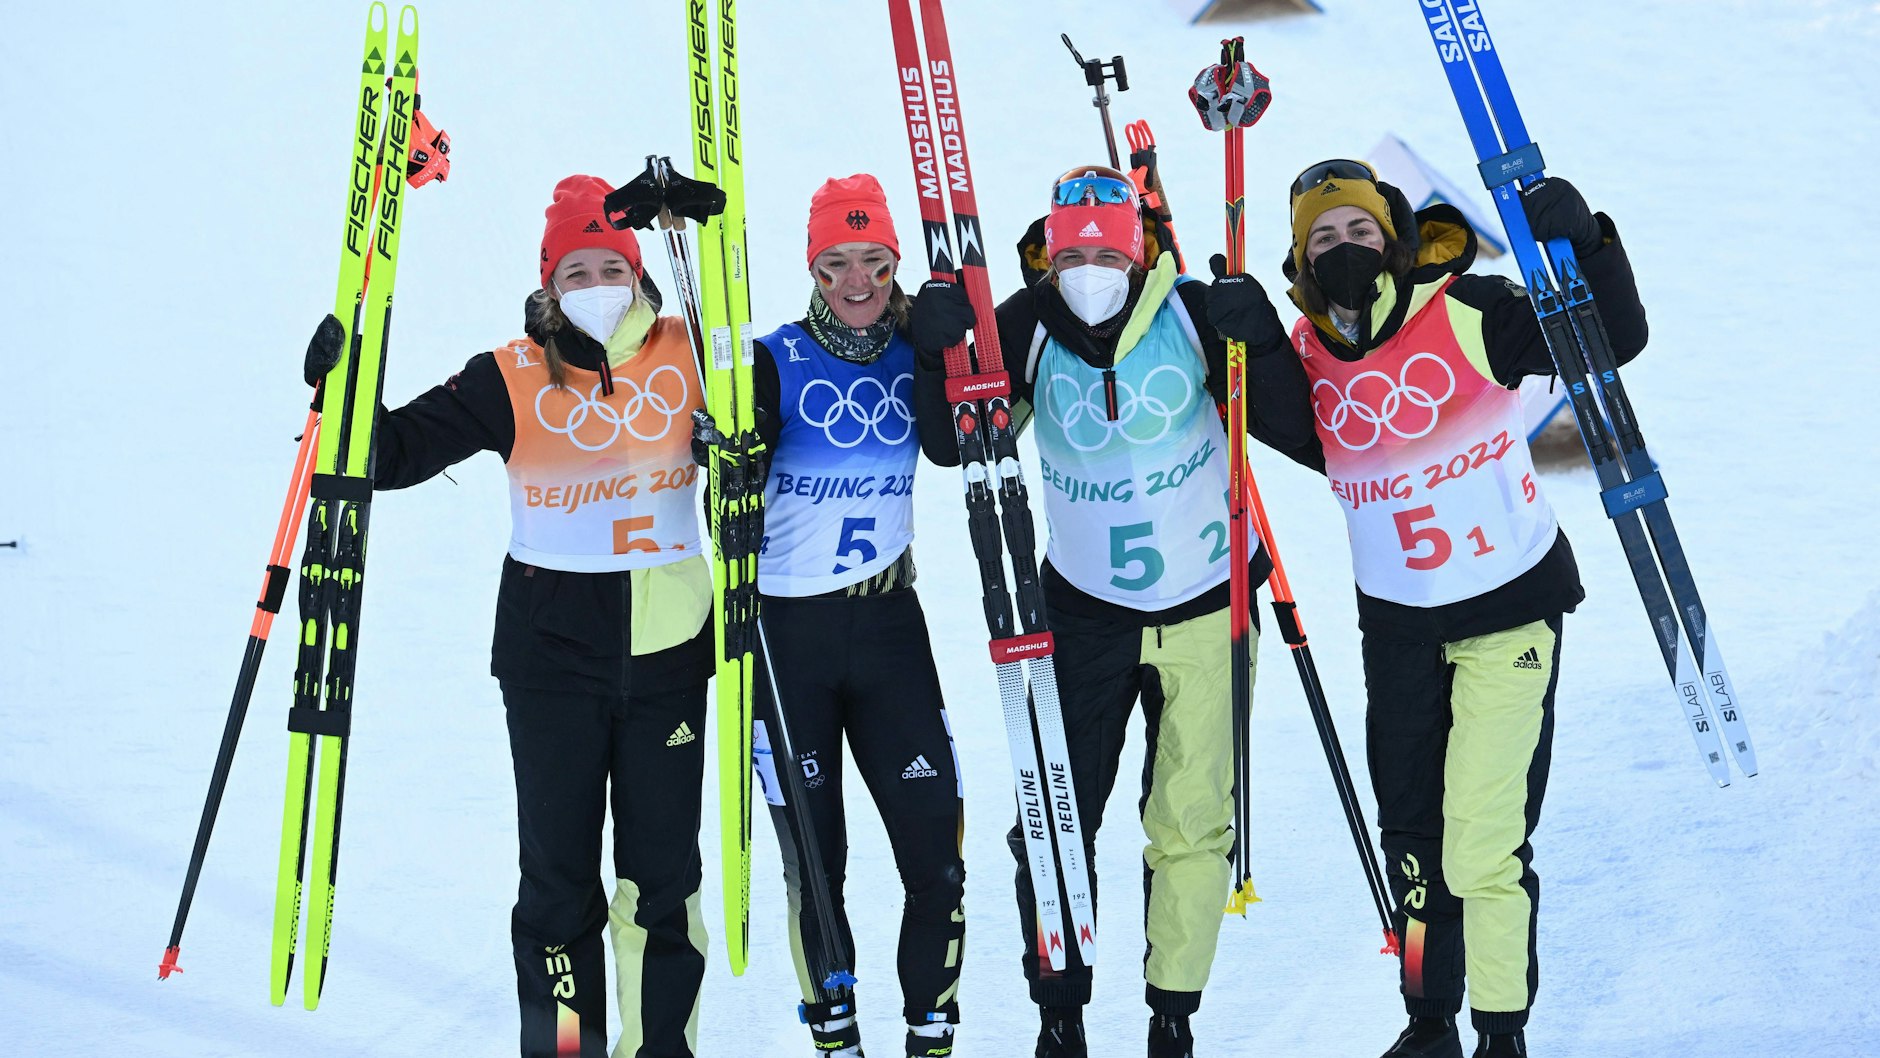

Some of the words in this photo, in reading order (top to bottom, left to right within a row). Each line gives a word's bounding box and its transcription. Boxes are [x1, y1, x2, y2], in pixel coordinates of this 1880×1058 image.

[690, 0, 714, 171] FISCHER
[722, 0, 739, 165] FISCHER
[902, 67, 939, 199] MADSHUS
[931, 60, 969, 192] MADSHUS
[347, 86, 379, 257] FISCHER
[377, 90, 410, 261] FISCHER
[963, 380, 1005, 392] MADSHUS
[776, 473, 876, 505] BEIJING
[1040, 456, 1134, 503] BEIJING
[1146, 438, 1217, 496] 2022
[1422, 430, 1516, 490] 2022
[1521, 472, 1536, 504] 5
[524, 474, 638, 514] BEIJING
[832, 517, 877, 575] 5
[1109, 520, 1165, 591] 5
[1199, 520, 1231, 564] 2
[1392, 503, 1453, 571] 5
[1466, 525, 1495, 557] 1
[1006, 641, 1048, 654] MADSHUS
[1513, 661, 1542, 670] adidas
[666, 732, 695, 747] adidas
[901, 768, 938, 780] adidas
[1050, 762, 1075, 833] REDLINE
[1020, 769, 1045, 840] REDLINE
[1038, 855, 1047, 877] SKATE
[1069, 848, 1077, 870] SKATE
[1042, 900, 1056, 908] 192
[1073, 893, 1086, 901] 192
